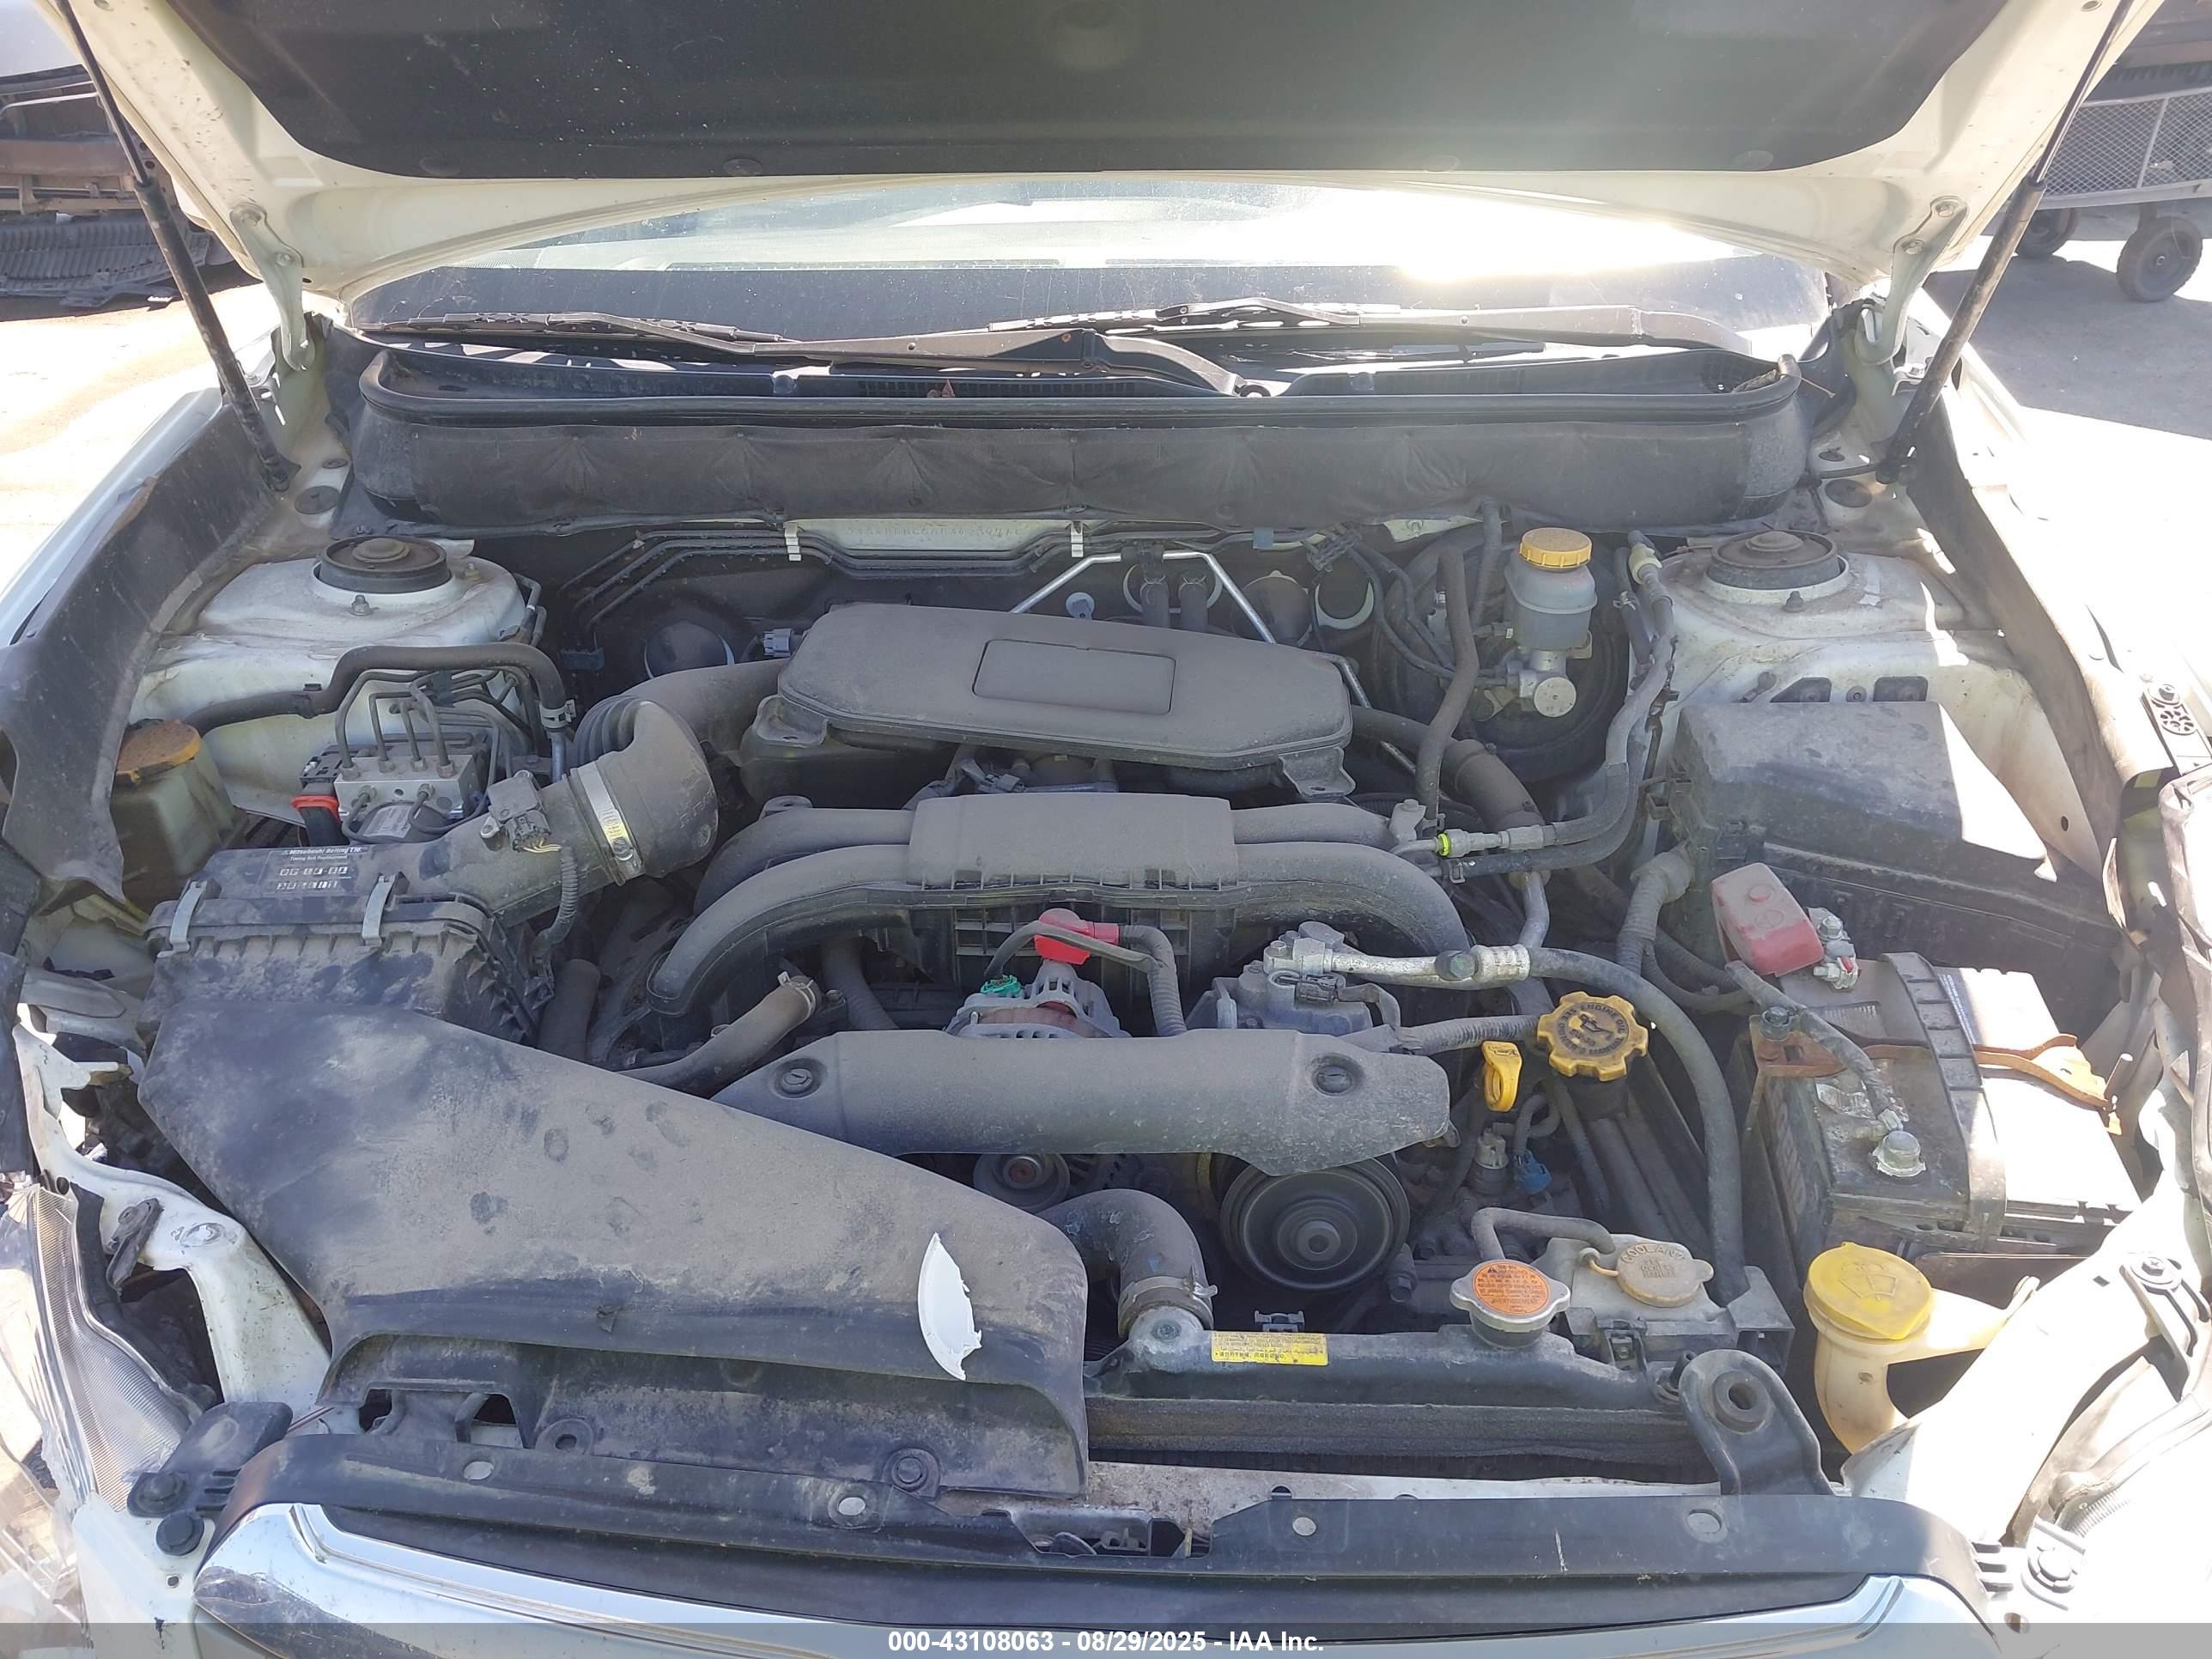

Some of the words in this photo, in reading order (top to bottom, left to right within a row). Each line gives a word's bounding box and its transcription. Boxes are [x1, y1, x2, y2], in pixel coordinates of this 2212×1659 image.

[1581, 1004, 1618, 1019] ENGINE
[1616, 1019, 1626, 1034] OIL
[1620, 1243, 1686, 1263] COOLANT
